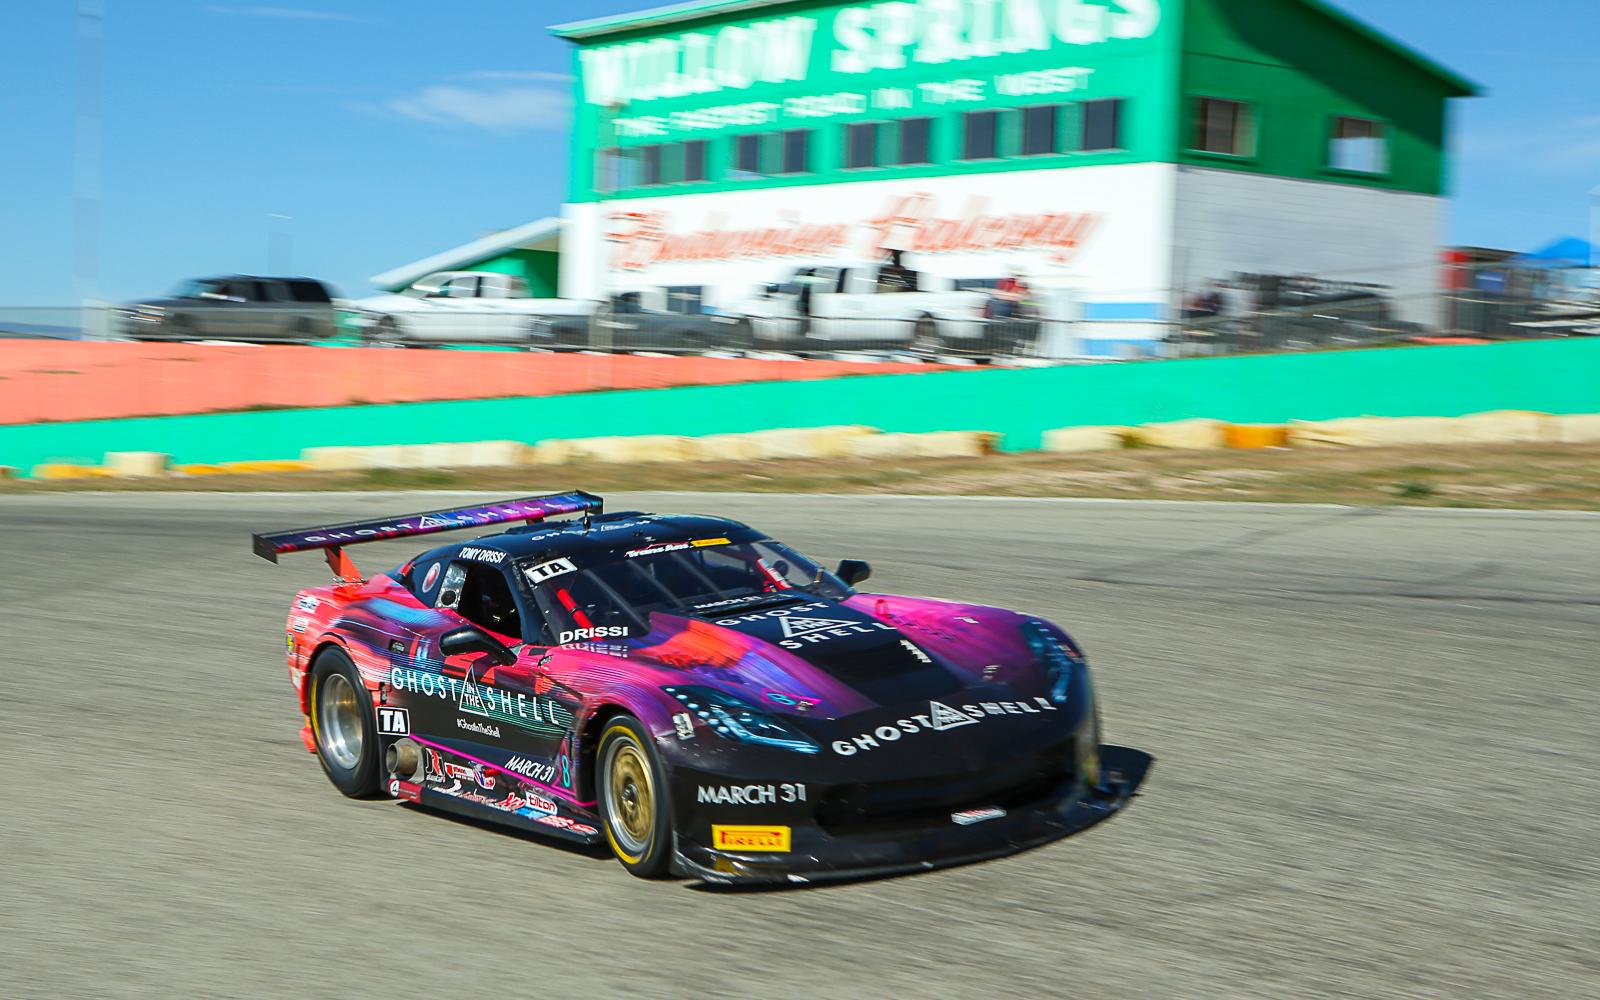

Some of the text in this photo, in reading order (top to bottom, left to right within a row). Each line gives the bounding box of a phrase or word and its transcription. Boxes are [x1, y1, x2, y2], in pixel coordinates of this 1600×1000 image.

[304, 523, 409, 542] GHOST
[459, 547, 506, 563] TONY DRISSI
[532, 562, 568, 578] TA
[715, 602, 829, 626] GHOST
[560, 627, 628, 645] DRISSI
[779, 622, 897, 649] SHELL
[391, 667, 459, 701] GHOST
[464, 694, 480, 708] THE
[487, 687, 559, 725] SHELL
[961, 697, 1057, 718] SHELL
[380, 710, 406, 733] TA
[832, 714, 934, 756] GHOST
[505, 755, 555, 782] MARCH 31
[562, 755, 570, 787] 8
[528, 795, 556, 811] tilton
[697, 783, 807, 804] MARCH 31
